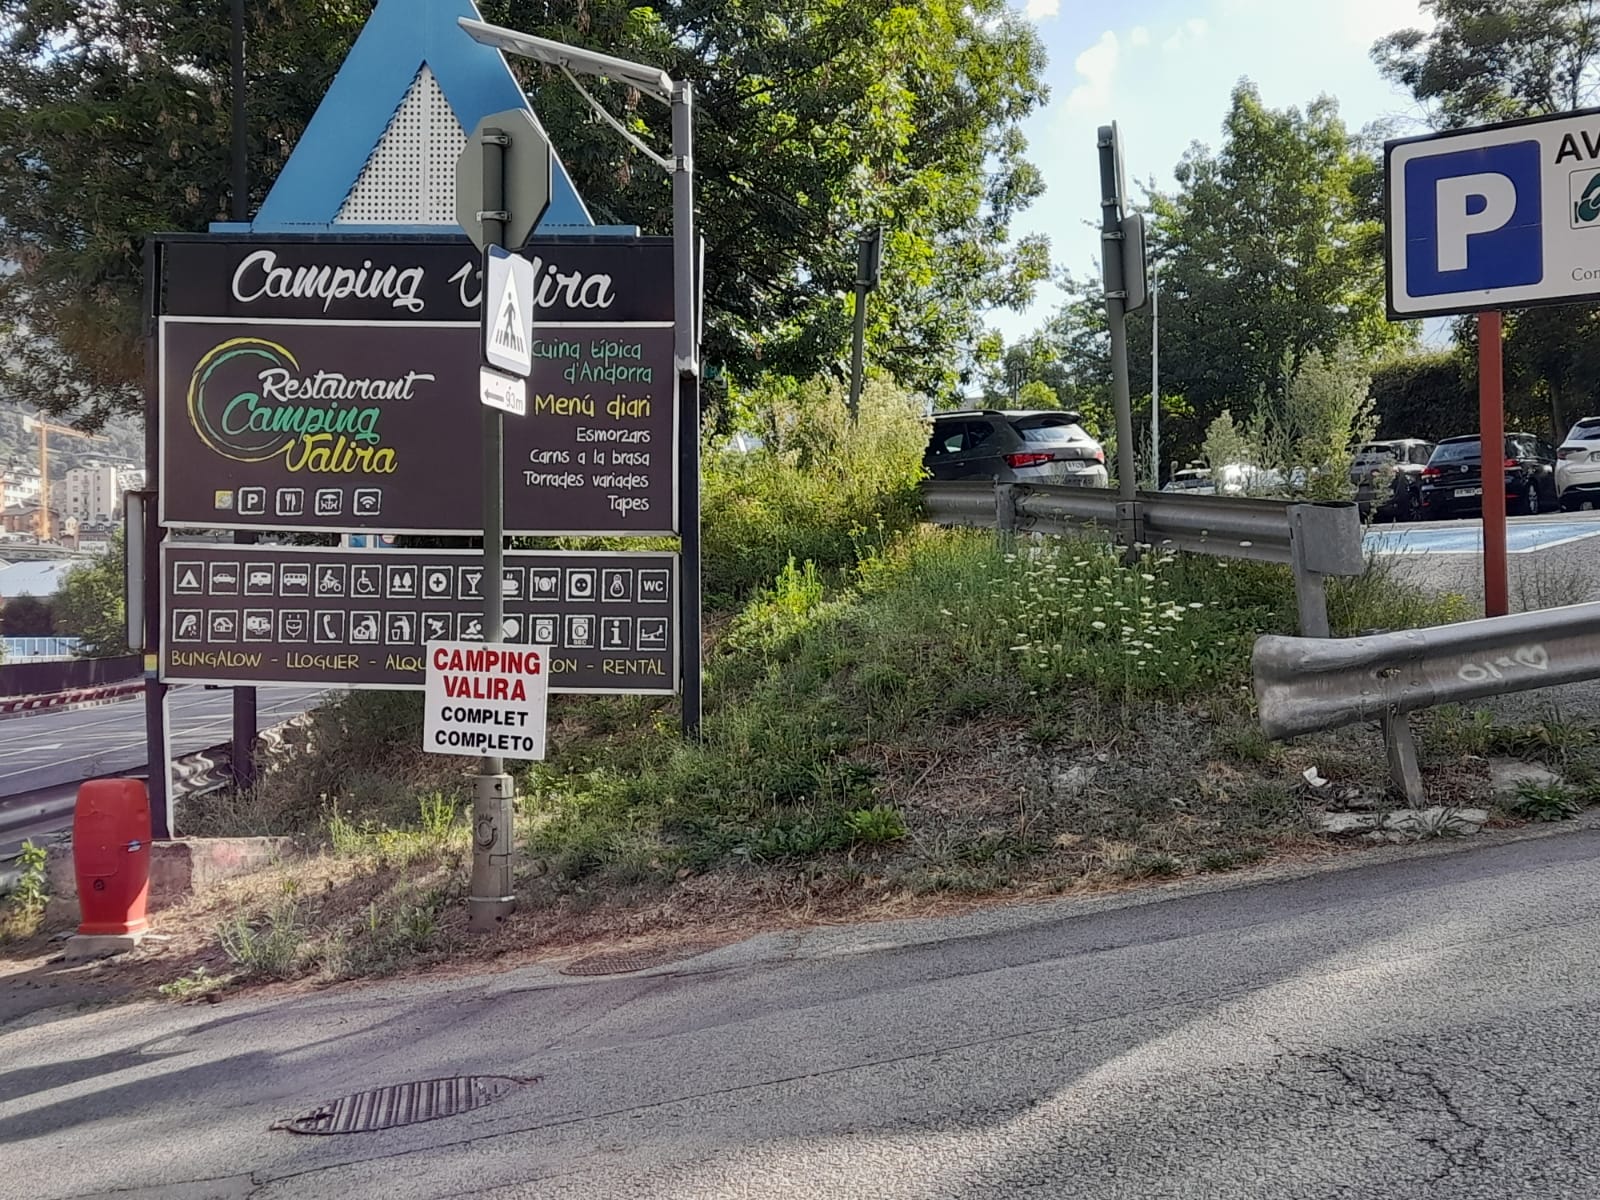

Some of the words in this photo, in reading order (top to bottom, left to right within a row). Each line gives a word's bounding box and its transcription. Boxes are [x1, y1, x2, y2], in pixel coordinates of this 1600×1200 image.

[1436, 172, 1517, 273] P
[232, 250, 425, 312] Camping
[533, 339, 580, 360] Cuina
[591, 339, 641, 367] típica
[258, 367, 435, 401] Restaurant
[564, 361, 652, 385] d'Andorra
[221, 393, 380, 444] Camping
[534, 394, 595, 417] Menú
[606, 394, 651, 420] diari
[576, 427, 651, 444] Esmorzars
[285, 433, 398, 473] Valira
[530, 449, 570, 465] Carns
[577, 452, 586, 465] a
[594, 449, 605, 465] la
[612, 449, 650, 466] brasa
[523, 471, 584, 488] Torrades
[592, 472, 649, 490] variades
[607, 495, 649, 517] Tapes
[643, 580, 664, 592] WC
[171, 650, 262, 667] BUNGALOW
[286, 652, 359, 669] LLOGUER
[602, 658, 666, 675] RENTAL
[433, 648, 541, 675] CAMPING
[443, 675, 526, 701] VALIRA
[441, 706, 528, 727] COMPLET
[435, 730, 534, 752] COMPLETO
